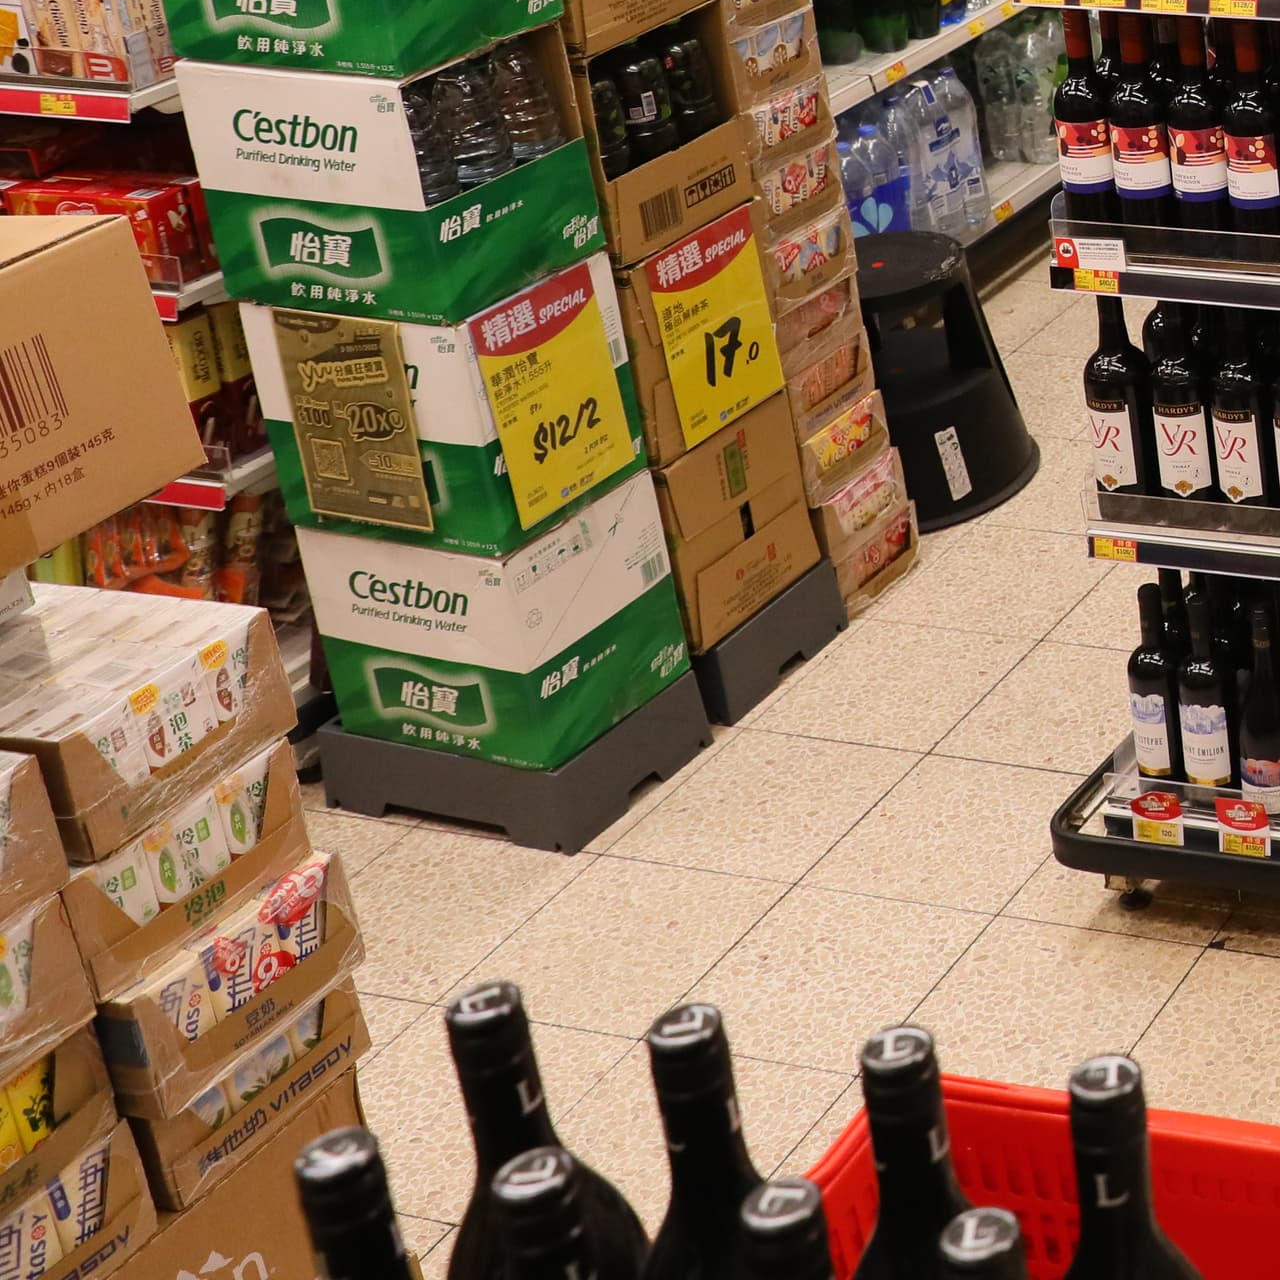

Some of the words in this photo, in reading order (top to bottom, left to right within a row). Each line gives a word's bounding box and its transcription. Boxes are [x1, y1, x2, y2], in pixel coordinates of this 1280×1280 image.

[236, 149, 276, 164] Purified
[278, 153, 320, 172] Drinking
[323, 158, 356, 172] Water
[440, 205, 482, 243] 怡寶
[290, 231, 352, 268] 怡寶
[705, 228, 746, 263] SPECIAL
[656, 240, 703, 288] 精選
[539, 288, 586, 324] SPECIAL
[481, 299, 536, 351] 精選
[352, 604, 390, 619] Purified
[392, 610, 430, 627] Drinking
[434, 618, 468, 634] Water
[401, 681, 459, 716] 怡寶
